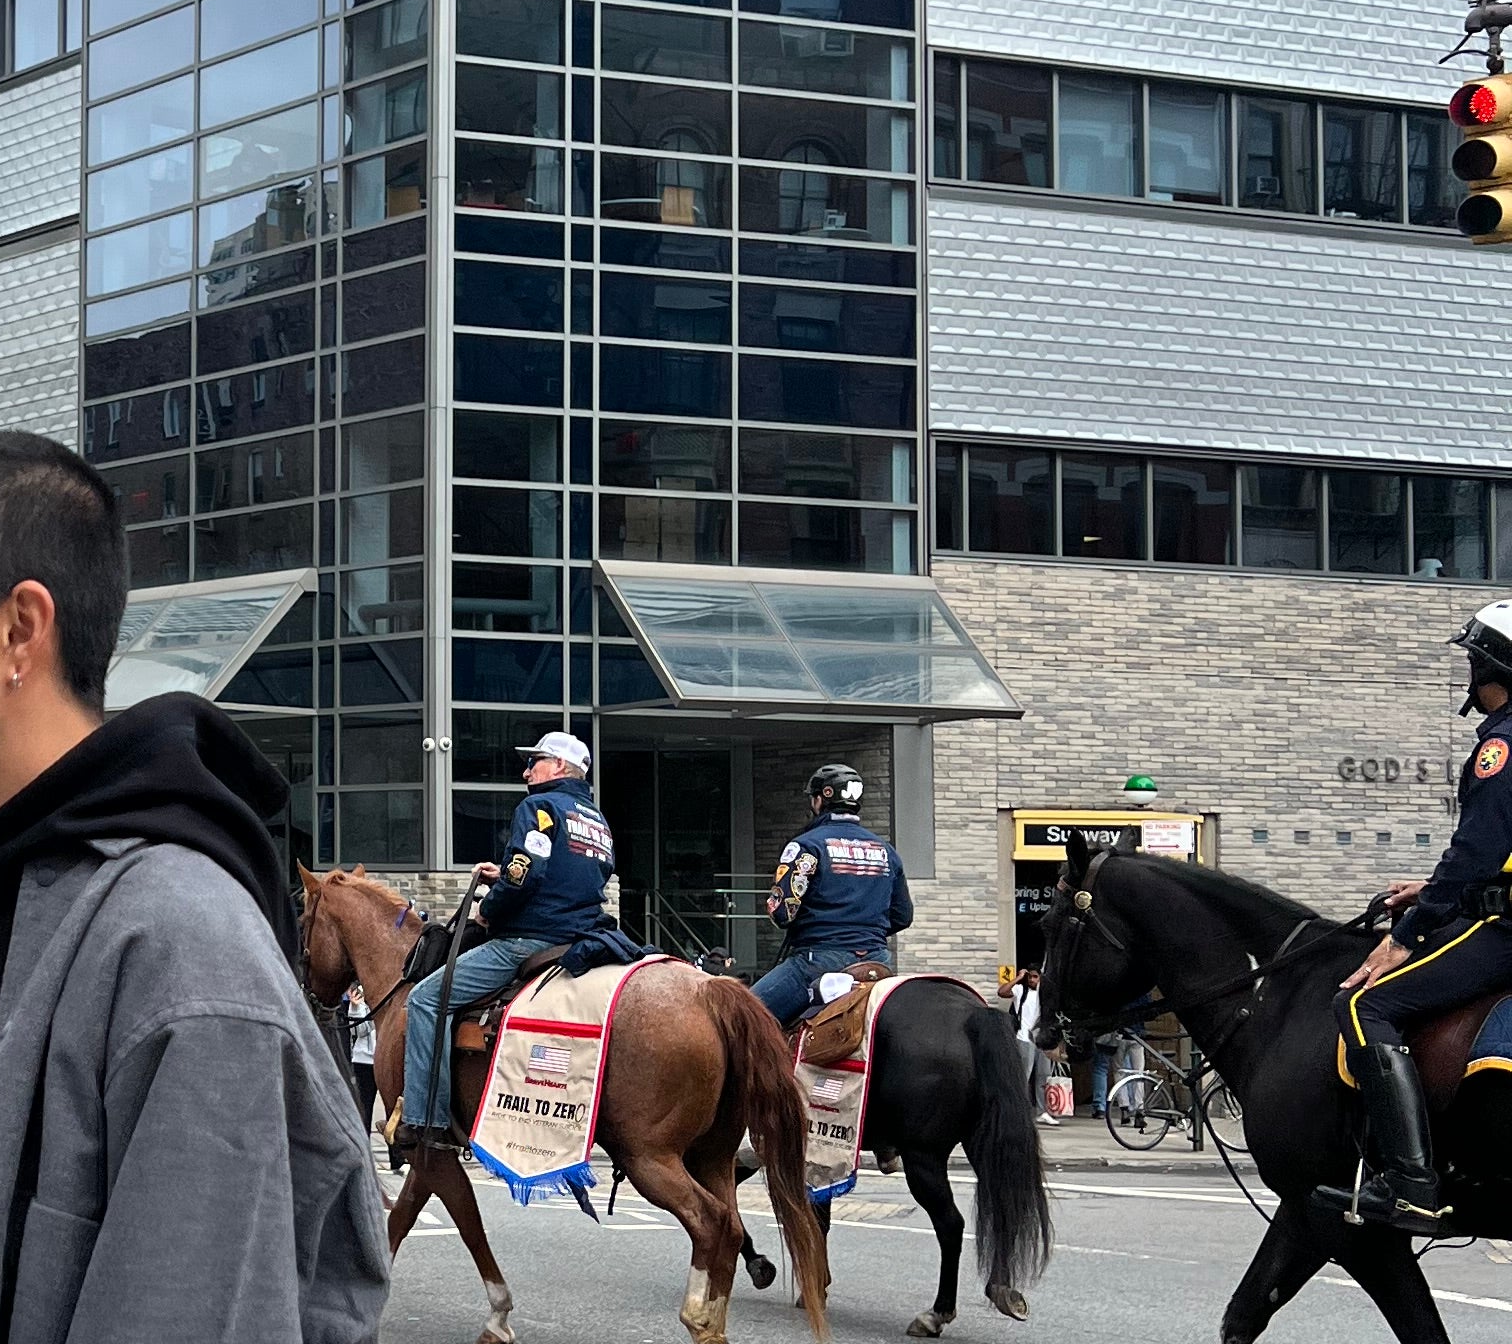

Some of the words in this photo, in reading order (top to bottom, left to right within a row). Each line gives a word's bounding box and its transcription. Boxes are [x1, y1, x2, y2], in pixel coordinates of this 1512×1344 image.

[566, 818, 591, 838] TRAIL
[590, 827, 600, 843] TO
[1046, 826, 1121, 846] Suway
[827, 845, 853, 858] TRAIL
[854, 847, 865, 859] TO
[496, 1093, 530, 1113] TRAIL
[535, 1099, 550, 1116] TO
[552, 1101, 586, 1123] ZERO
[533, 1119, 558, 1128] VETERAN
[817, 1121, 828, 1136] TO
[830, 1124, 855, 1143] ZERO
[506, 1141, 556, 1157] #trailtozero
